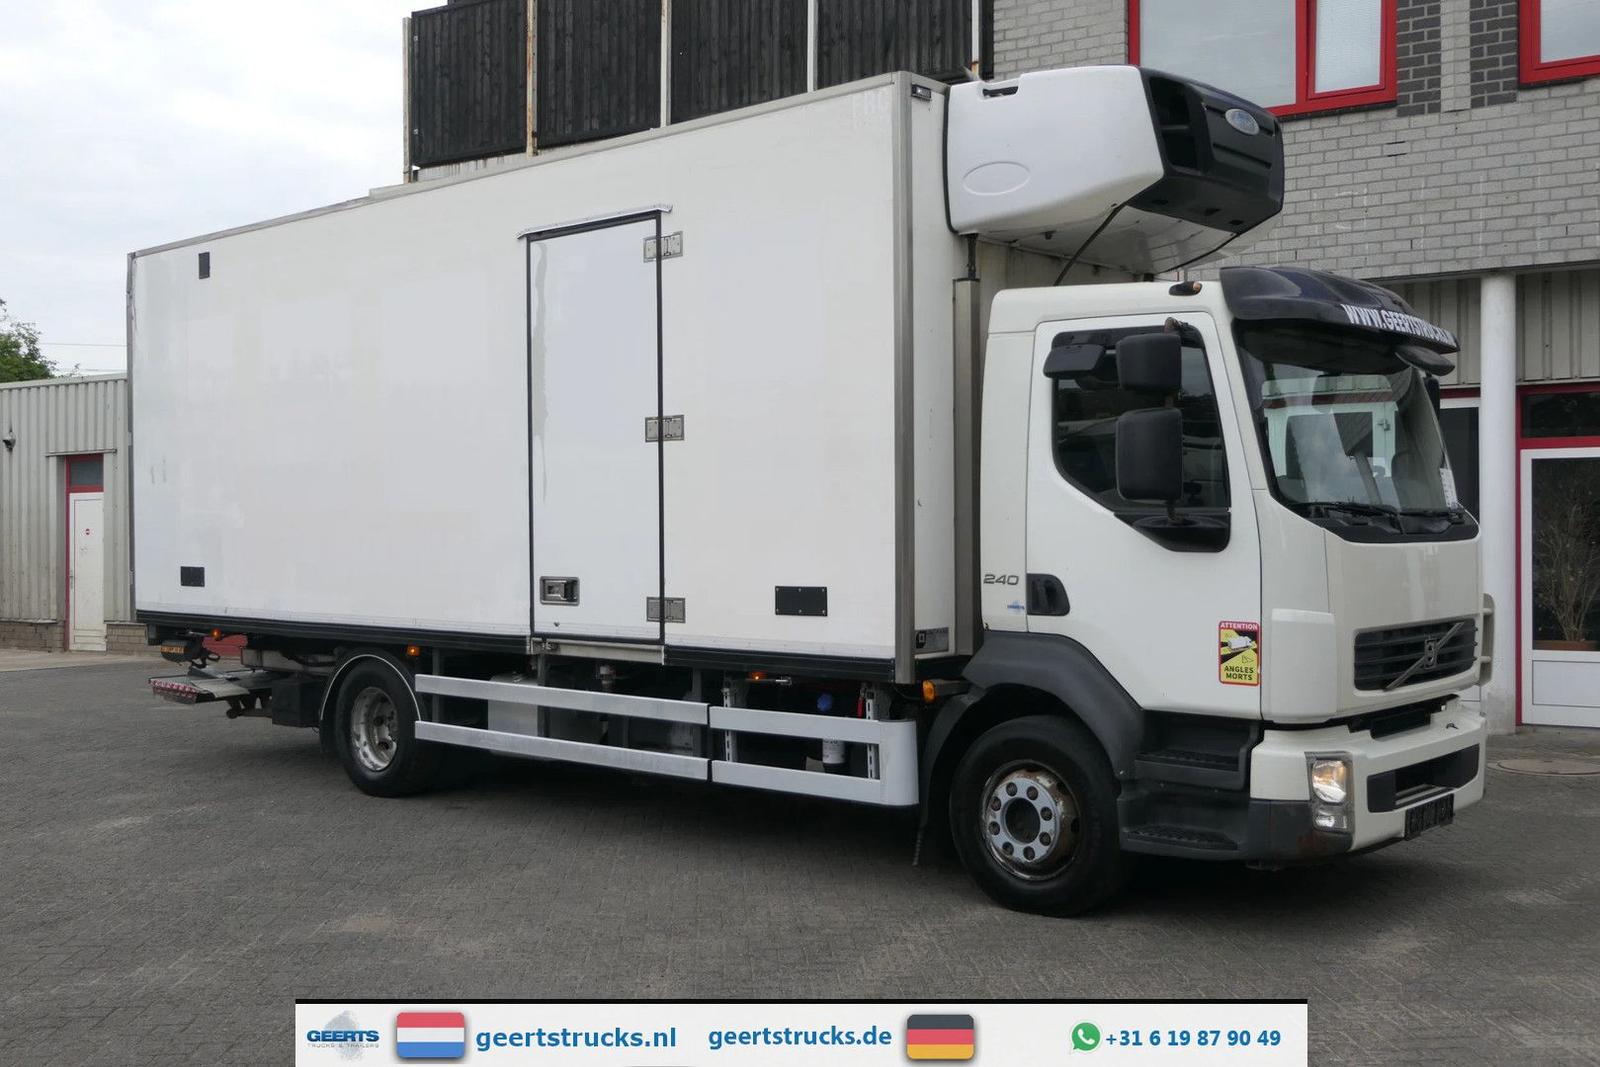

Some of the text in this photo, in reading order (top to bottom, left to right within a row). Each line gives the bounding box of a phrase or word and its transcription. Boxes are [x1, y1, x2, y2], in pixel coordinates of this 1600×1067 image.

[983, 574, 1019, 586] 240
[1220, 622, 1258, 630] ATTENTION
[1224, 665, 1254, 674] ANGLES
[1225, 673, 1253, 681] MORTS
